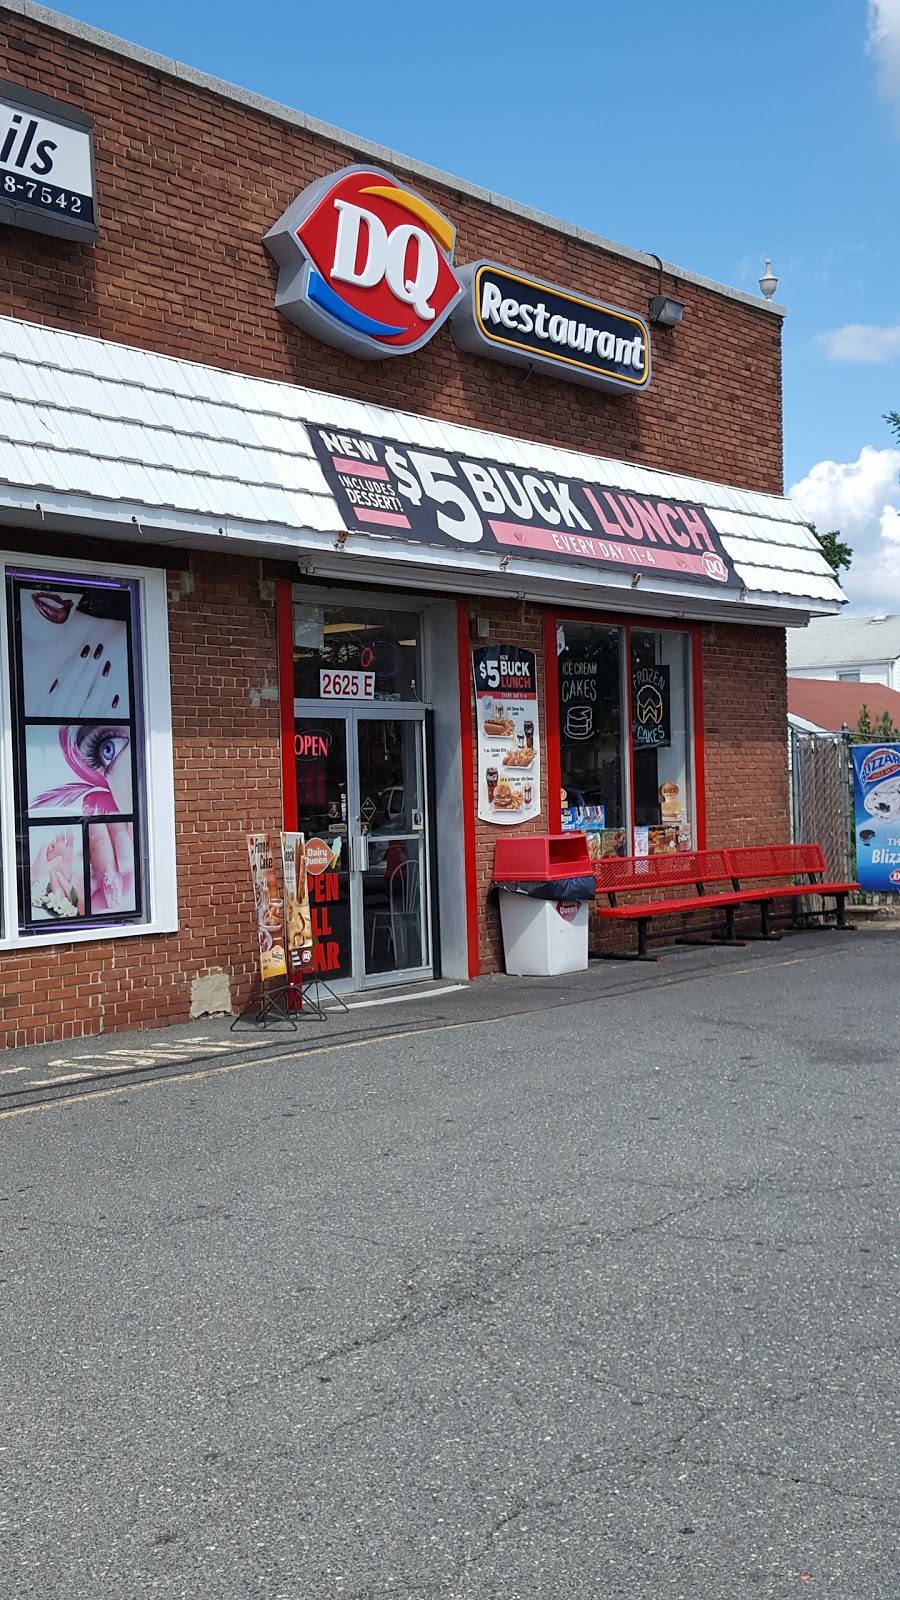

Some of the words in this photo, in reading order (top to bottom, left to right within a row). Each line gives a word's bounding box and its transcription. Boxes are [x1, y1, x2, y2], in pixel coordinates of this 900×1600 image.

[0, 114, 58, 176] ils
[3, 175, 82, 214] 8-7542
[330, 198, 440, 321] DQ
[480, 281, 645, 371] Restaurant
[318, 430, 379, 463] NEW
[338, 474, 397, 497] INCLUDES
[346, 489, 405, 513] DESSERT!
[384, 445, 484, 544] $5
[457, 460, 593, 532] BUCK
[582, 487, 717, 553] LUNCH
[551, 533, 597, 557] EVERY
[600, 542, 626, 561] DAY
[628, 548, 656, 565] 11-4
[704, 558, 726, 578] DQ
[479, 660, 501, 689] $5
[500, 660, 531, 677] BUCK
[574, 662, 598, 676] CREAM
[632, 668, 666, 690] FROZEN
[322, 673, 359, 696] 2625
[364, 675, 373, 697] E
[501, 676, 532, 689] LUNCH
[561, 679, 597, 703] CAKES
[294, 734, 329, 758] OPEN
[637, 724, 665, 744] CAKES
[306, 848, 328, 857] Dairy
